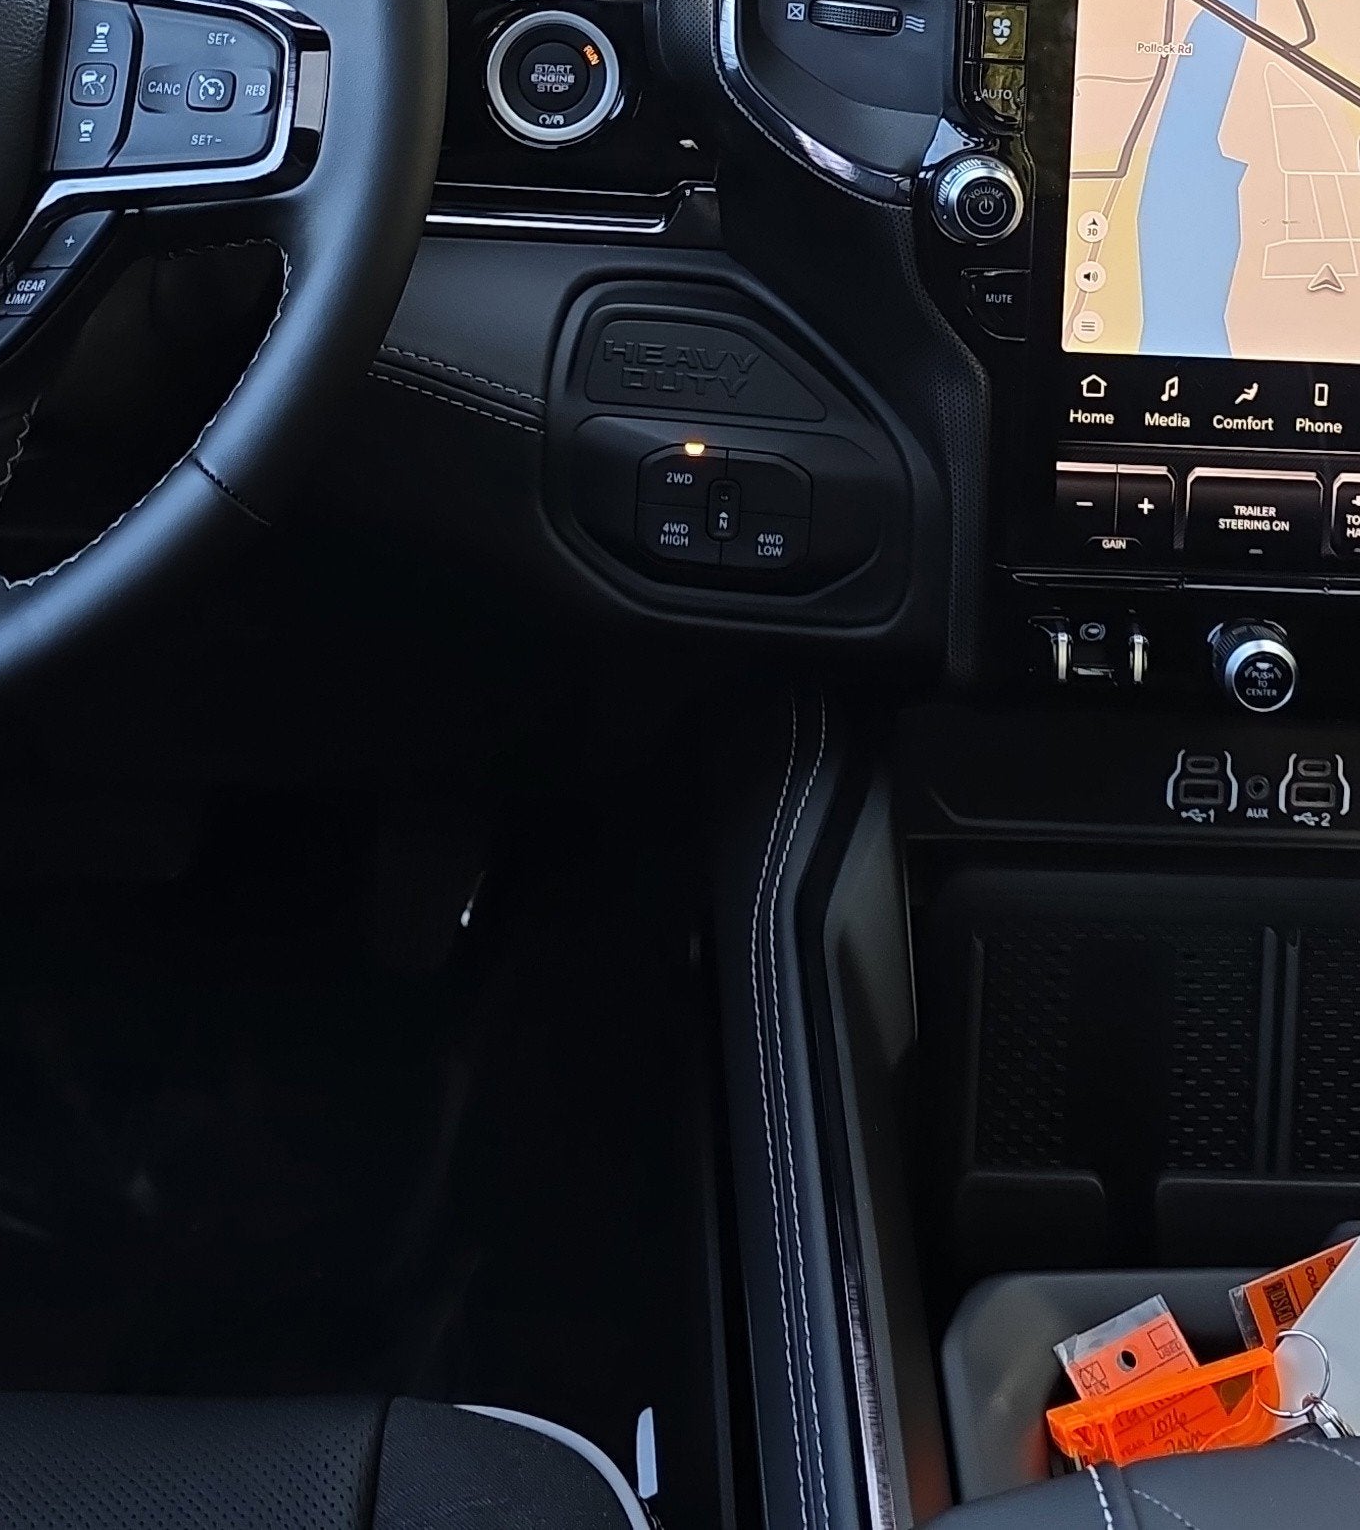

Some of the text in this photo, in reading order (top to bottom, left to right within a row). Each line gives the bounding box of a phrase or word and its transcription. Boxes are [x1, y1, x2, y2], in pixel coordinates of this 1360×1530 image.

[582, 44, 600, 66] RUN
[1136, 42, 1193, 55] Pollock Rd
[534, 63, 573, 74] START
[530, 73, 575, 83] ENGINE
[147, 80, 182, 97] CANC
[244, 83, 267, 98] RES
[536, 83, 570, 93] STOP
[980, 88, 1013, 101] AUTO
[966, 185, 1005, 202] VOLUME
[1086, 227, 1099, 237] 3D
[16, 278, 47, 292] GEAR
[4, 292, 36, 306] LIMIT
[984, 292, 1013, 305] MUTE
[602, 339, 762, 374] HEAVY
[620, 366, 749, 399] DUTY
[1068, 408, 1116, 426] Home
[1143, 411, 1192, 429] Media
[1211, 414, 1275, 432] Comfort
[1295, 417, 1344, 436] Phone
[665, 472, 694, 487] 2WD
[1232, 504, 1277, 518] TRAILER
[661, 521, 690, 536] 4WD
[717, 517, 729, 530] N
[1218, 517, 1290, 533] STEERING ON
[659, 533, 690, 548] HIGH
[756, 533, 785, 547] 4WD
[1101, 538, 1127, 551] GAIN
[756, 544, 784, 558] LOW
[1250, 670, 1275, 681] PUSH
[1257, 680, 1268, 689] TO
[1244, 687, 1278, 698] CENTER
[1207, 809, 1216, 824] 1
[1244, 807, 1270, 821] AUX
[1320, 813, 1332, 827] 2
[1156, 1340, 1183, 1361] USED
